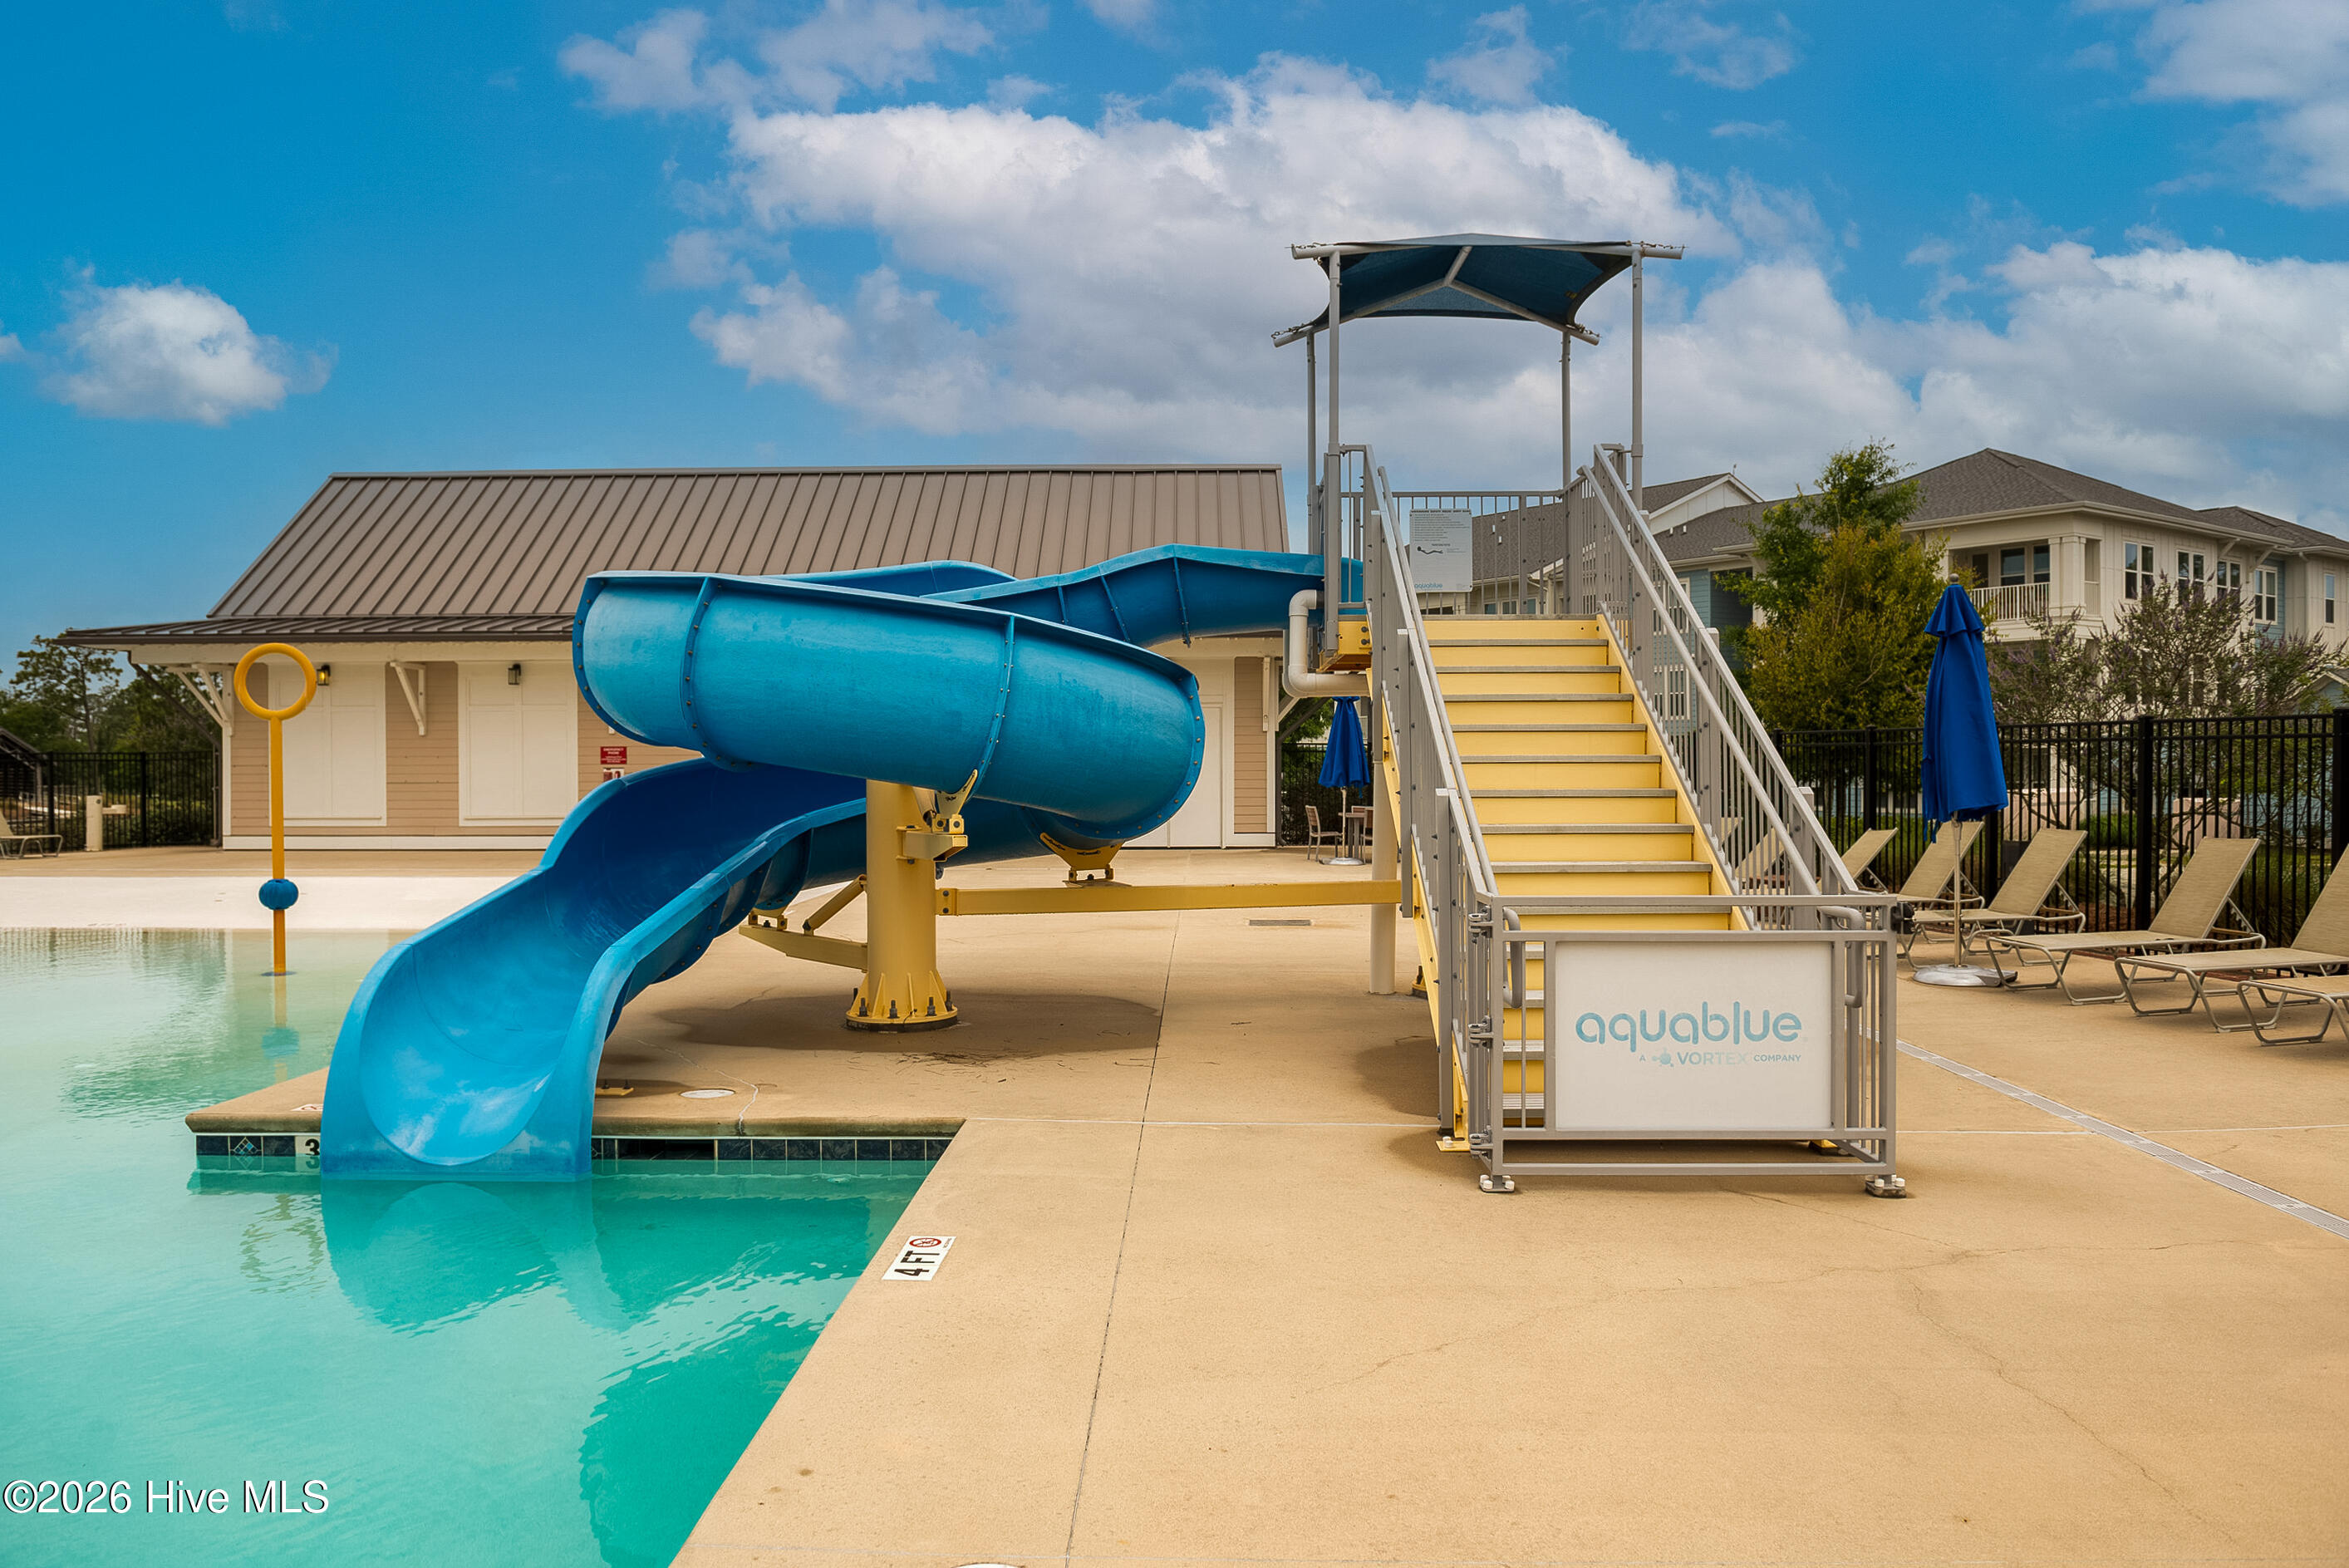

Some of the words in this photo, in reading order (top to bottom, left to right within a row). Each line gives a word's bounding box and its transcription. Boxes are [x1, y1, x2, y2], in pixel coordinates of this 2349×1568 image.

[1575, 1001, 1802, 1052] aquablue
[1677, 1051, 1747, 1065] VORTEX
[1753, 1054, 1801, 1063] COMPANY
[305, 1138, 320, 1157] 3
